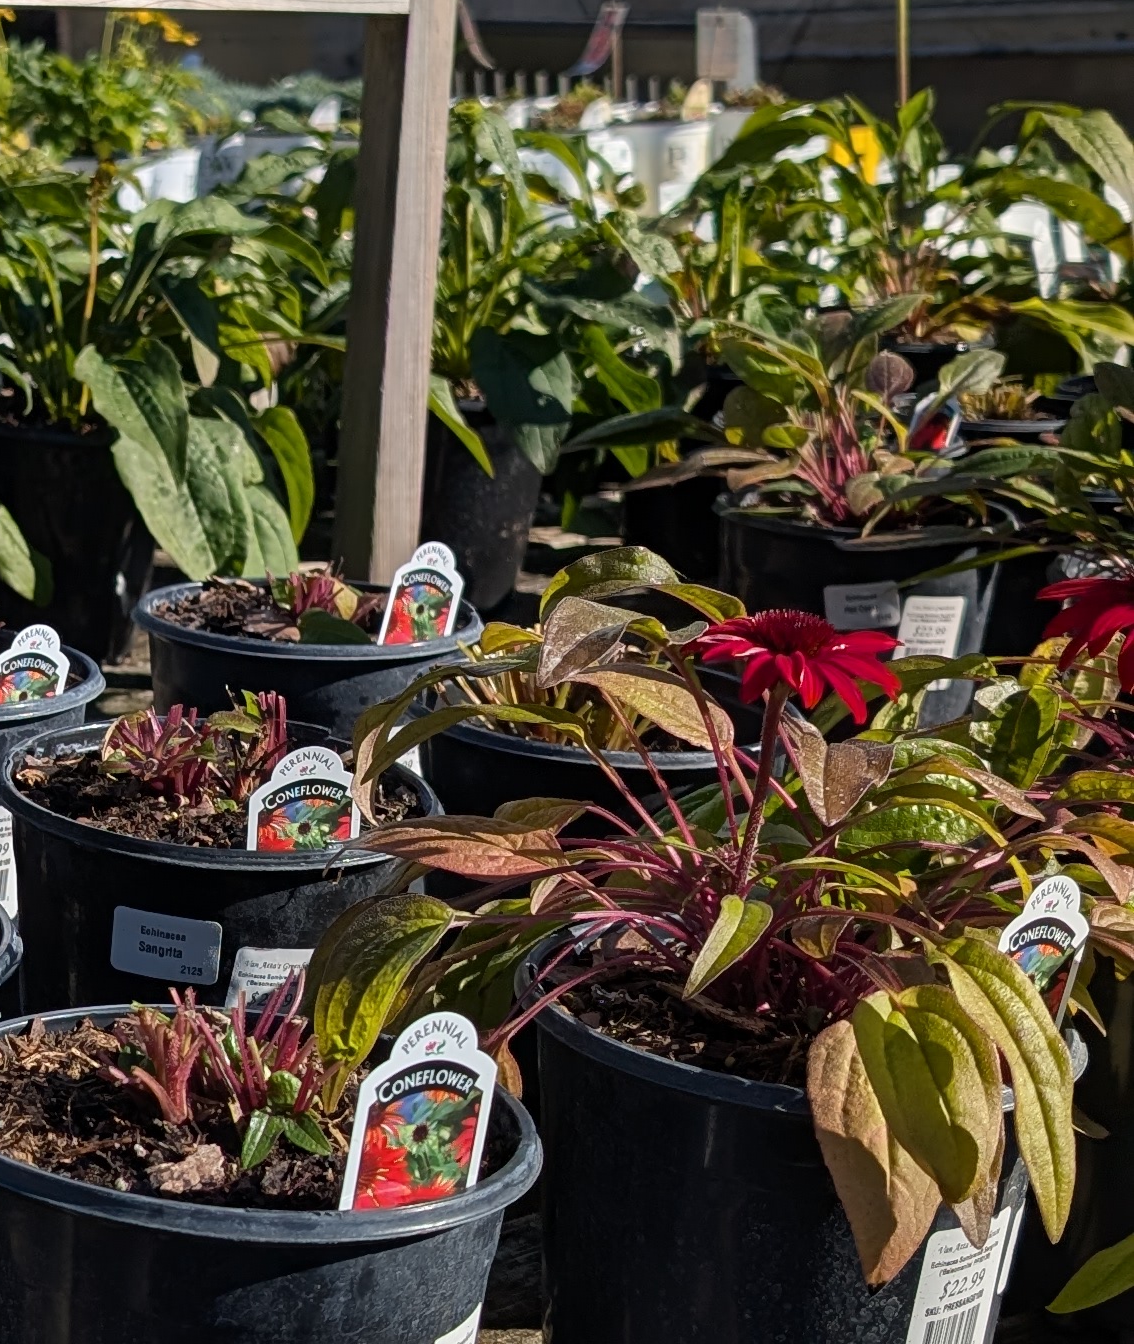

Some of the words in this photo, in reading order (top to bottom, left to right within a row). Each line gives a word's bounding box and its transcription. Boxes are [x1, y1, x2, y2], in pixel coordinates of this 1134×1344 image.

[402, 571, 450, 593] CONEFLOWER
[17, 627, 55, 649] PERENNIAL
[2, 657, 56, 677] CONEFLOWER
[279, 751, 335, 777] PERENNIAL
[265, 784, 344, 810] CONEFLOWER
[1030, 880, 1075, 911] PERENNIAL
[140, 924, 187, 942] Echinacea
[1009, 924, 1072, 952] CONEFLOWER
[138, 941, 183, 960] Sangrita
[180, 965, 203, 977] 2125
[401, 1019, 469, 1055] PERENNIAL
[378, 1068, 475, 1104] CONEFLOWER
[938, 1267, 986, 1303] $22.99
